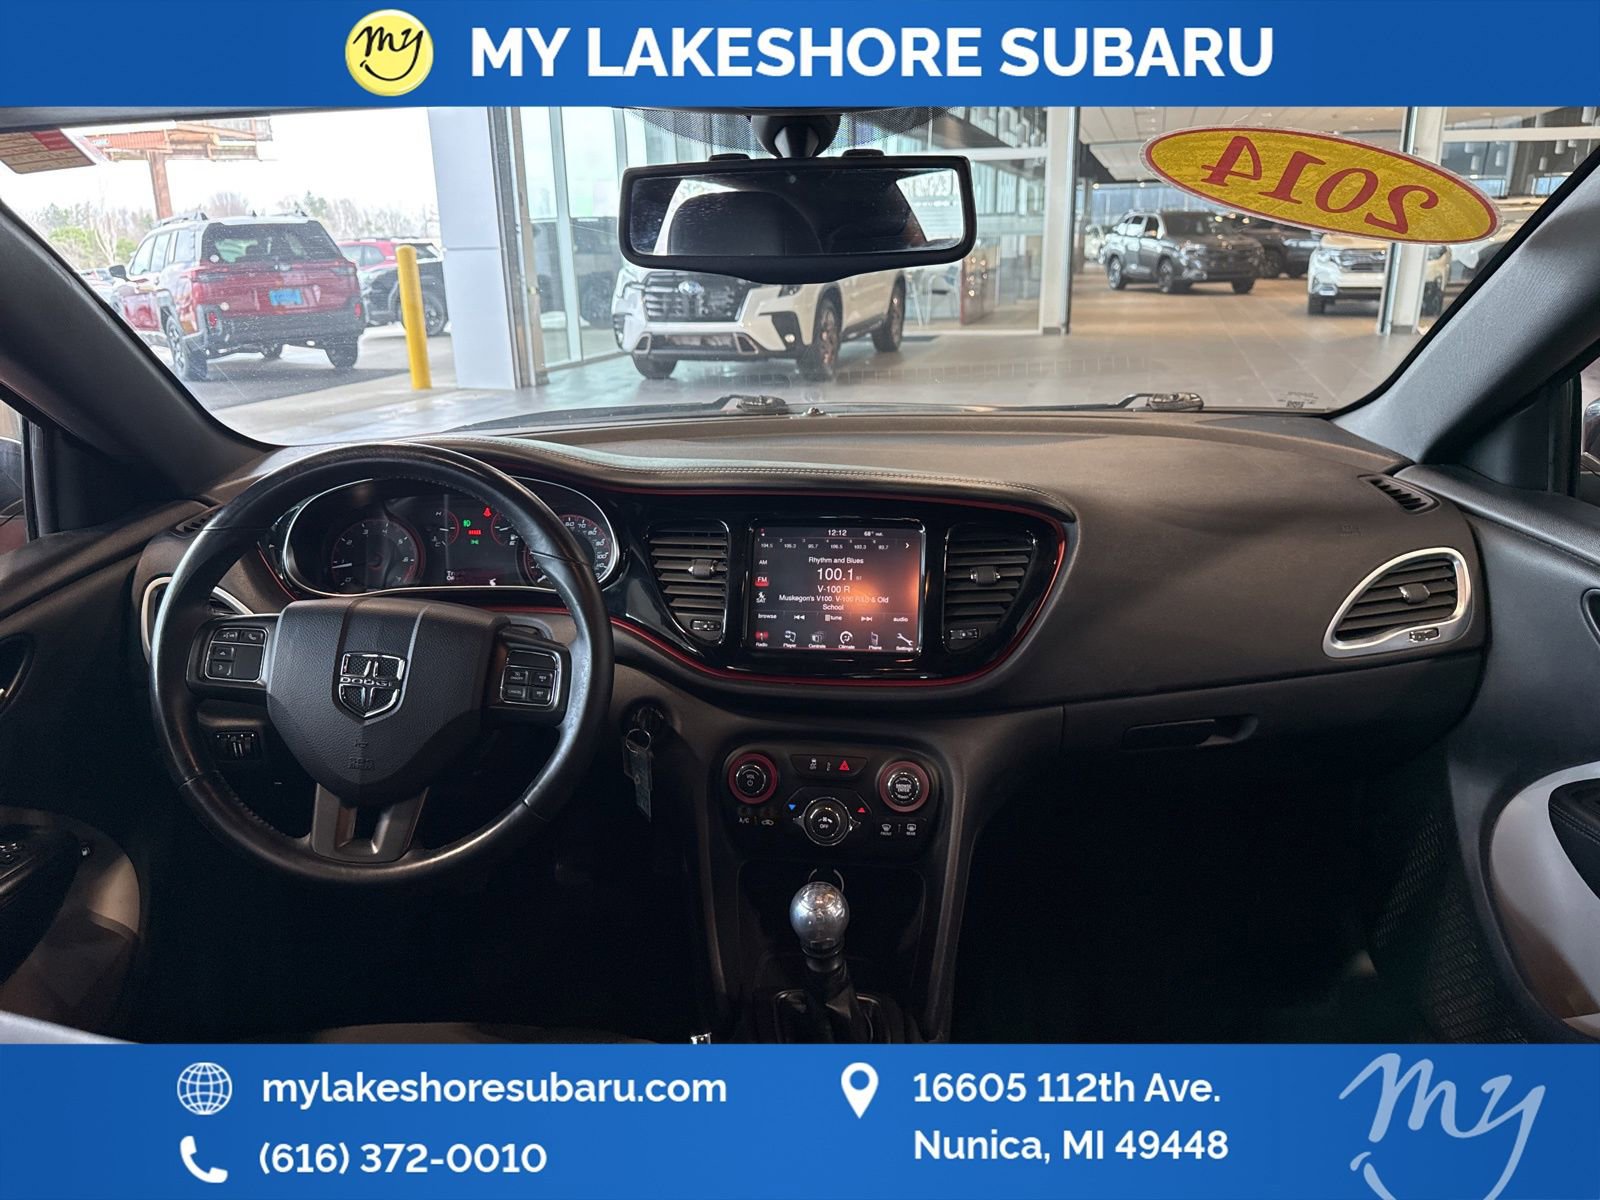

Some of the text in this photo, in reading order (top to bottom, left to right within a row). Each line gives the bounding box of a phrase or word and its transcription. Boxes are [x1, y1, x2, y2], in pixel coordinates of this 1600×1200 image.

[828, 529, 848, 537] 12:12
[808, 557, 833, 565] Rhythm
[817, 568, 854, 581] 100.1
[817, 585, 842, 594] V-100
